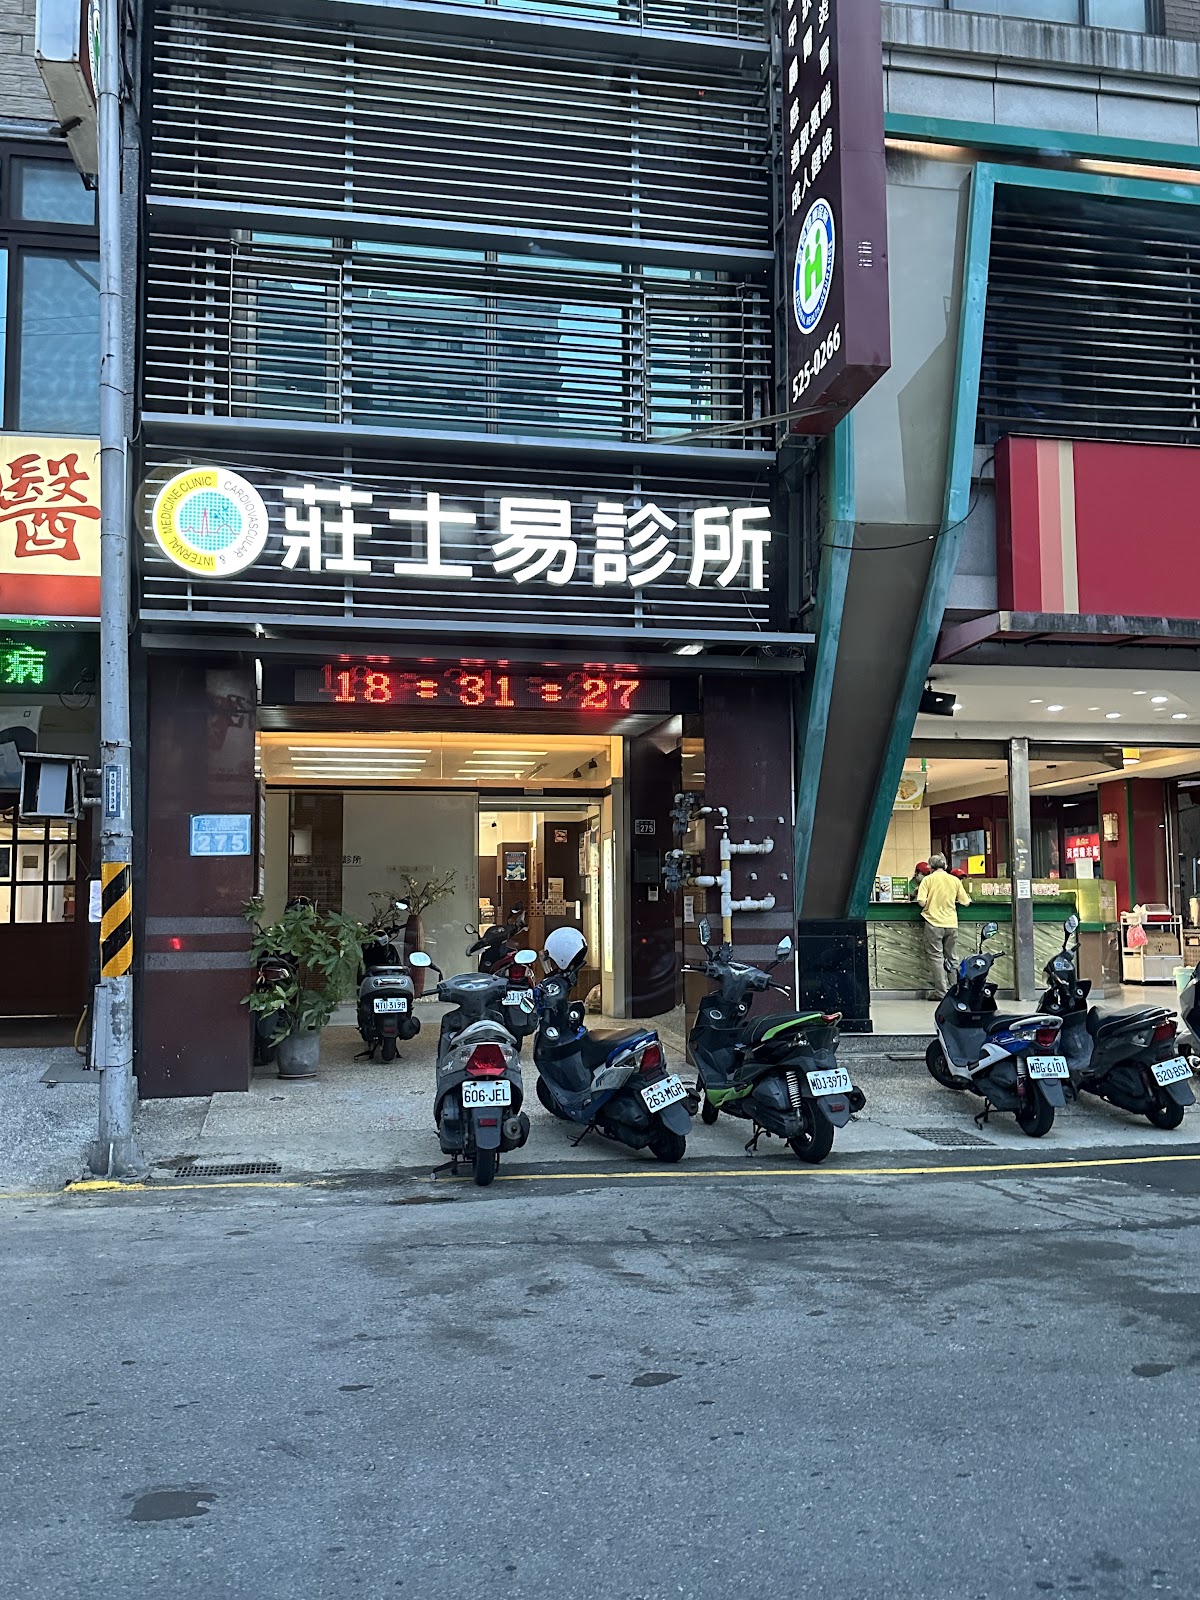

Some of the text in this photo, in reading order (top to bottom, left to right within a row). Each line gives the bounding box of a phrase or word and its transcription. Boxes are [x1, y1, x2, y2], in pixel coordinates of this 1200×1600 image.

[792, 323, 841, 404] 525-0266
[161, 476, 214, 566] INTERNAL MEDICINE CLINIC
[223, 481, 259, 558] CARDIOVASCULAR
[281, 484, 771, 591] 莊士易診所
[5, 646, 47, 684] 病
[640, 824, 654, 833] 275
[197, 834, 244, 851] 275
[1029, 1062, 1066, 1073] MBG-6101
[1155, 1063, 1191, 1082] 520-BSX
[810, 1074, 848, 1091] MDJ-3979
[464, 1088, 510, 1103] 606-JEL
[646, 1082, 685, 1109] 263-MGR
